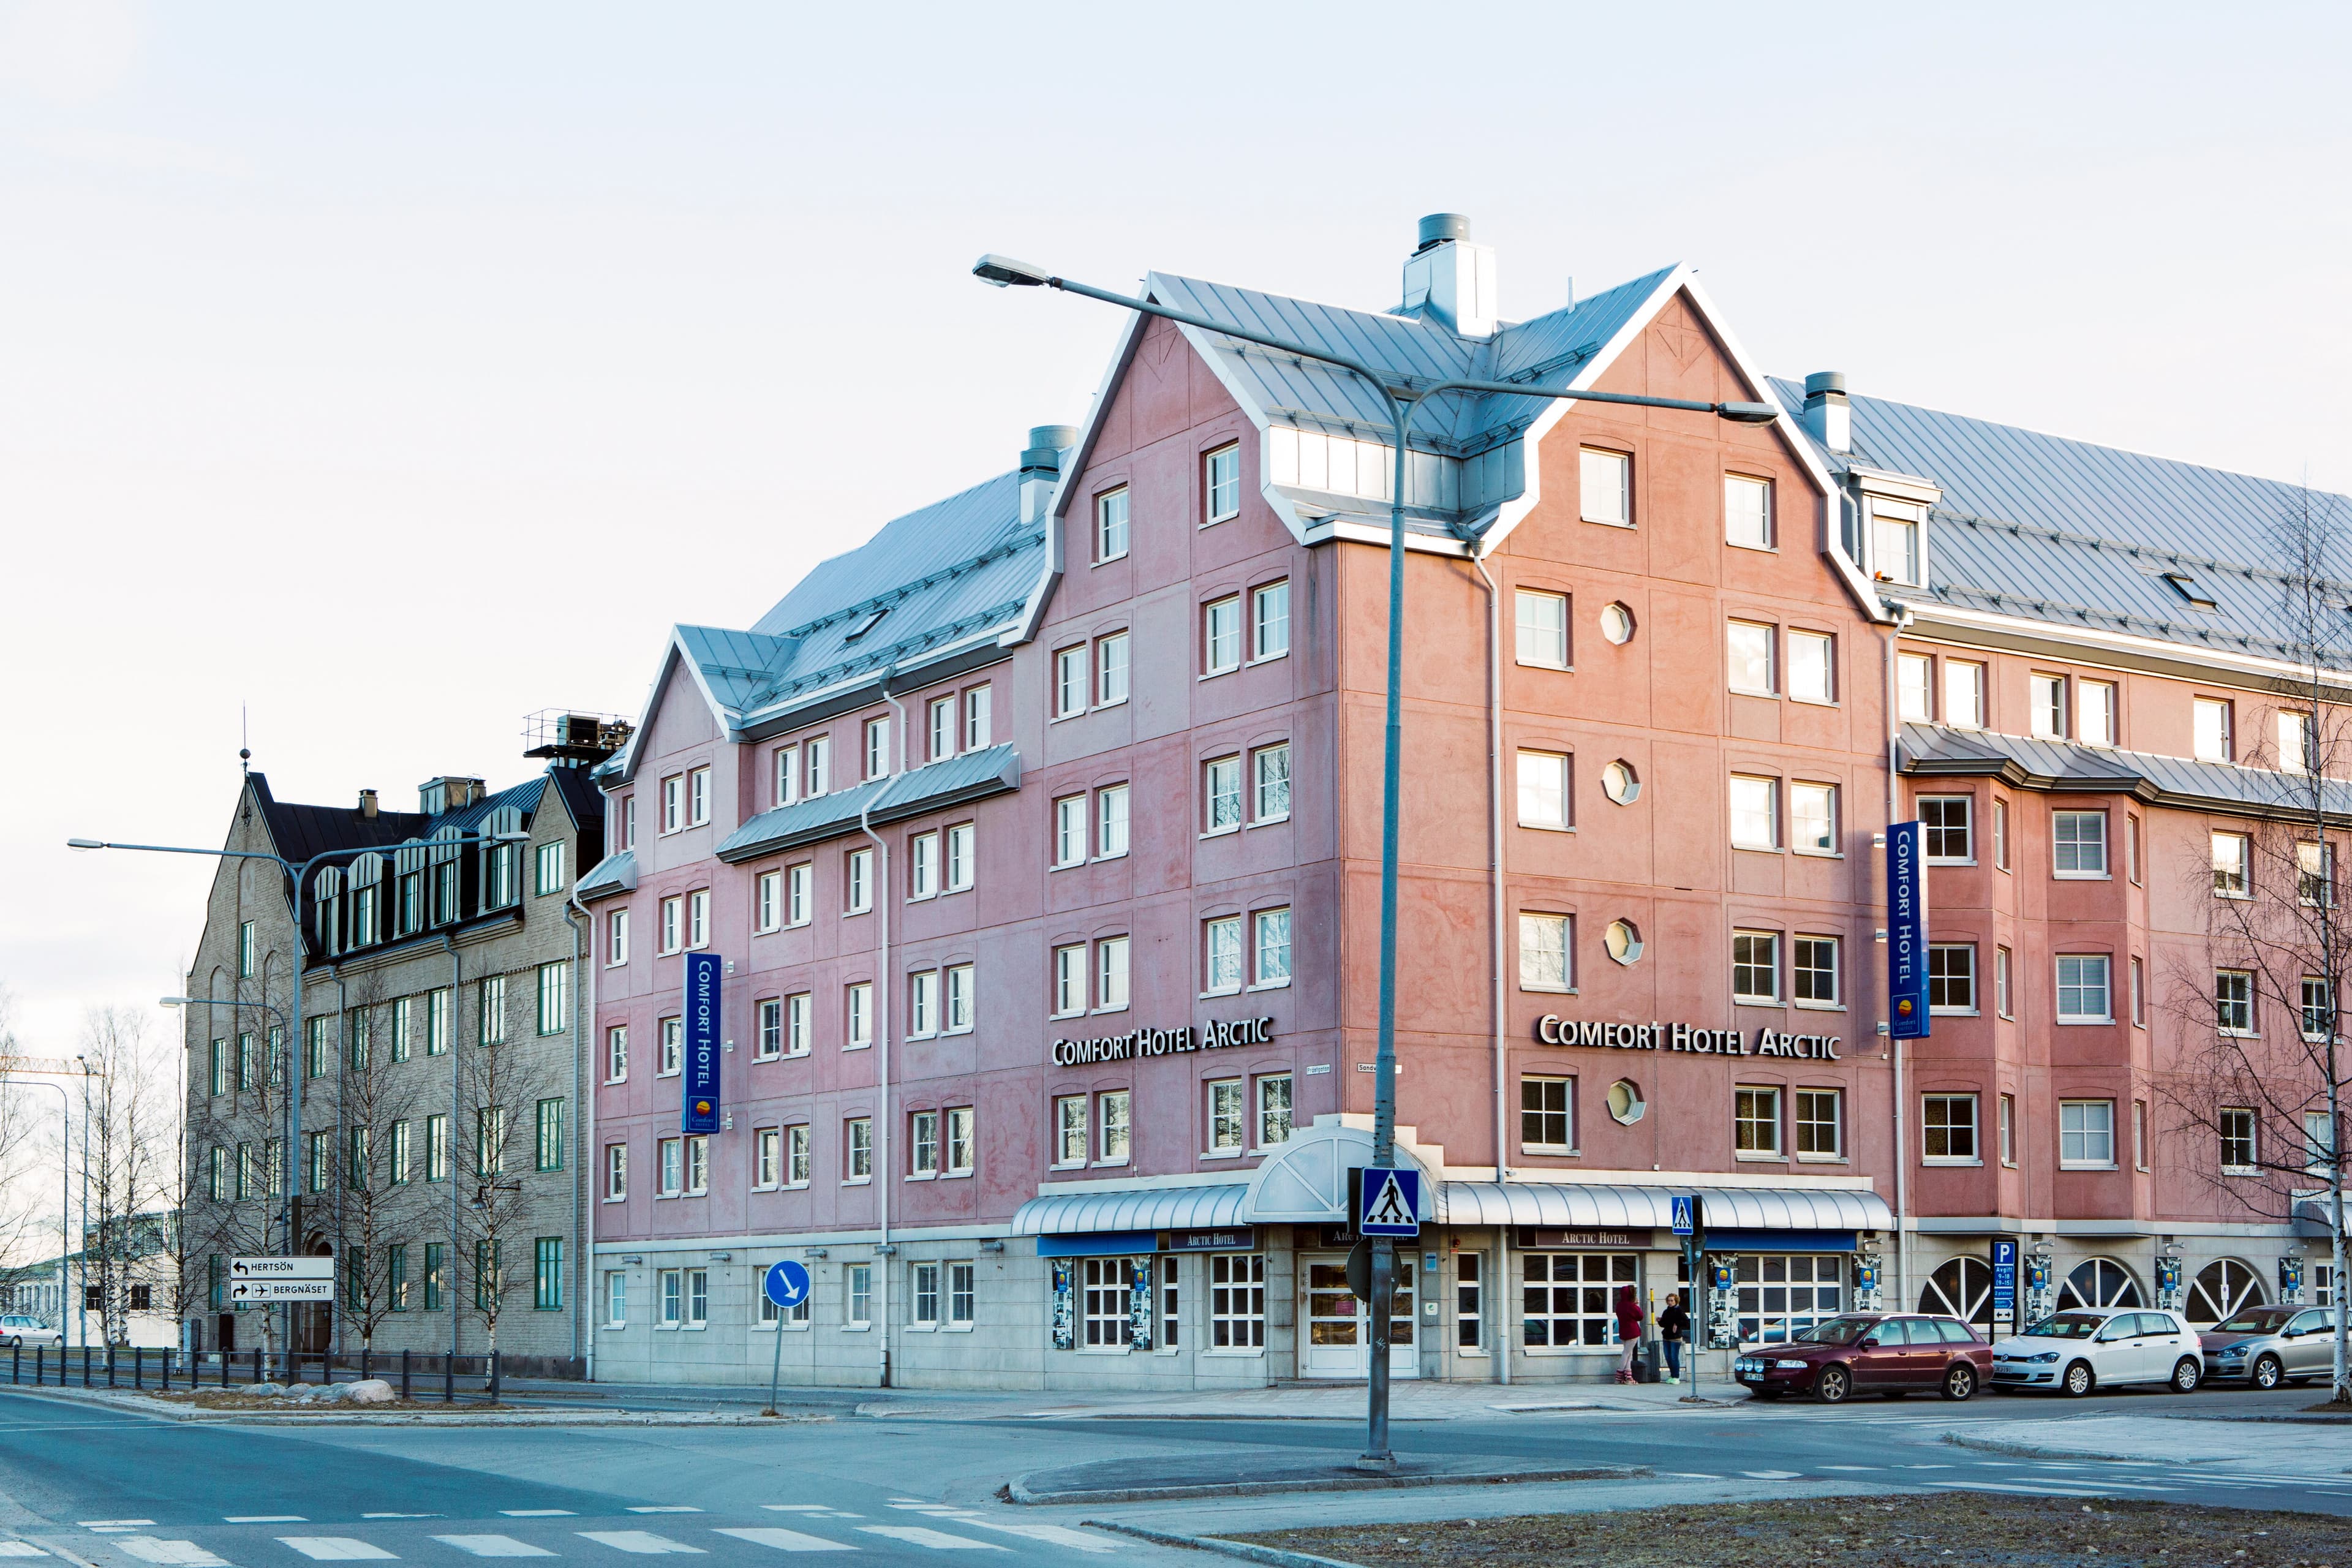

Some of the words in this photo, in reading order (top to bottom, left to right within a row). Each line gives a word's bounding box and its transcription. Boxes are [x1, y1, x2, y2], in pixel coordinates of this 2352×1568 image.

[1898, 831, 1910, 919] COMFORT
[1899, 925, 1912, 984] HOTEL
[698, 960, 712, 1034] COMFORT
[1052, 1033, 1134, 1066] COMFORT
[1138, 1027, 1196, 1057] HOTEL
[1202, 1017, 1271, 1049] ARCTIC
[1540, 1014, 1664, 1049] COMFORT
[1672, 1022, 1751, 1055] HOTEL
[1758, 1028, 1841, 1060] ARCTIC
[698, 1039, 711, 1088] HOTEL
[1187, 1234, 1212, 1246] ARCTIC
[1213, 1233, 1236, 1245] HOTEL
[1562, 1231, 1596, 1244] ARCTIC
[1599, 1232, 1630, 1245] HOTEL
[2000, 1244, 2010, 1262] P
[251, 1262, 293, 1271] HERTSÖN
[274, 1284, 327, 1294] BERGNÄSET
